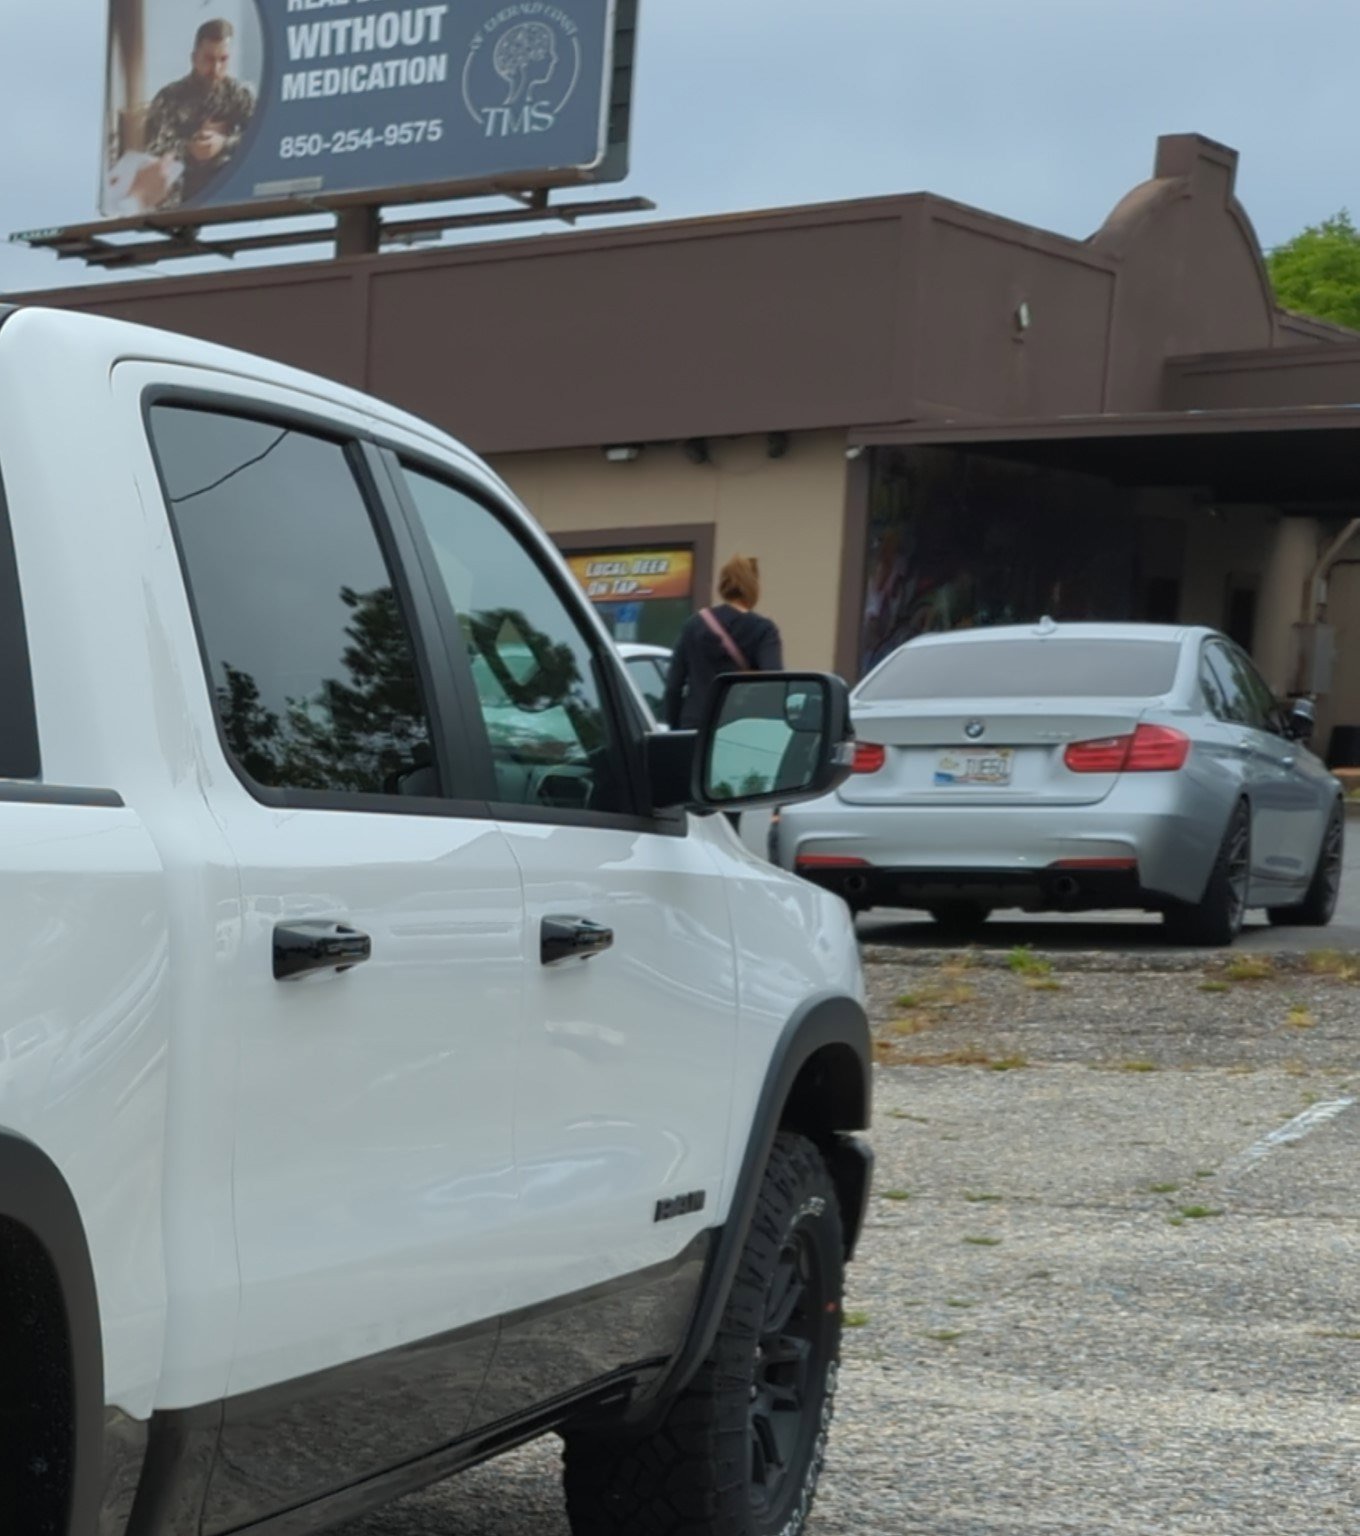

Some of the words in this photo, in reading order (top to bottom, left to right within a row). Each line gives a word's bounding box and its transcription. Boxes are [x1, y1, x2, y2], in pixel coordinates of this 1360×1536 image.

[287, 5, 448, 61] WITHOUT
[282, 54, 448, 101] MEDICATION
[279, 119, 443, 158] 850-254-9575
[480, 100, 555, 137] TMS
